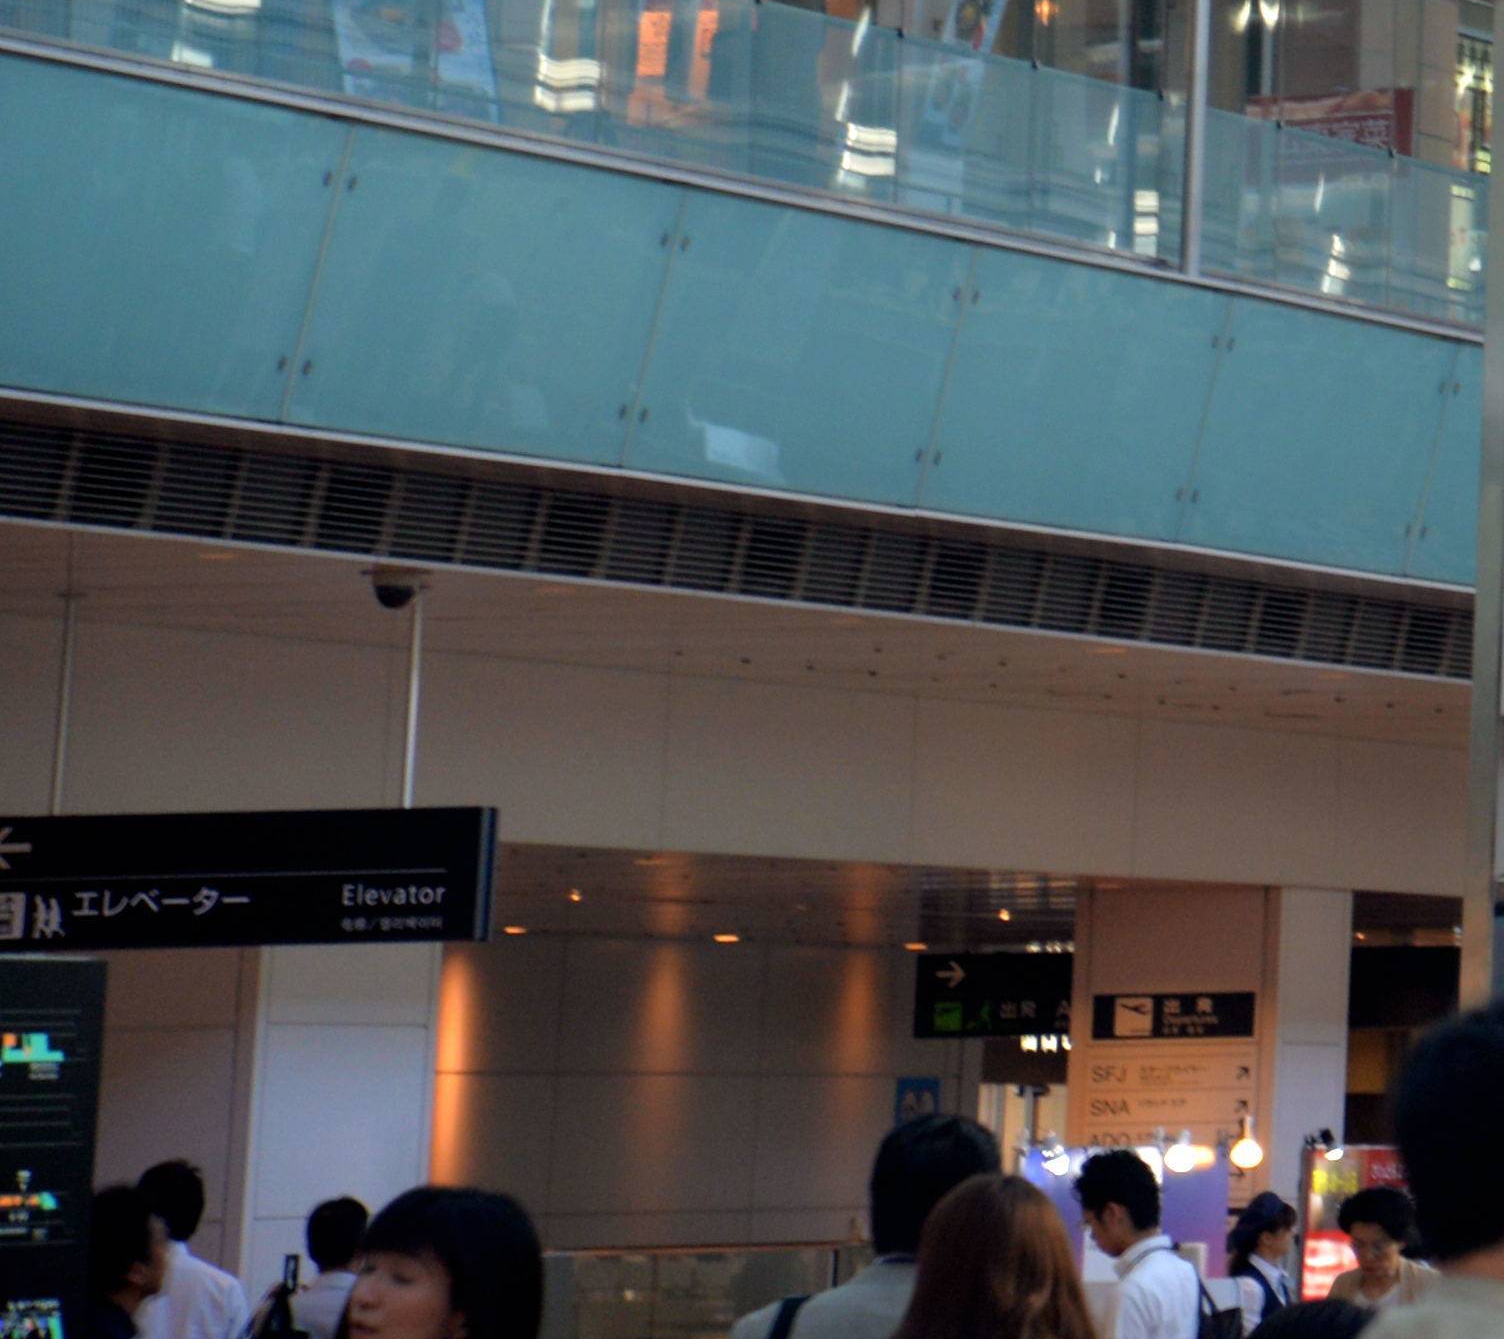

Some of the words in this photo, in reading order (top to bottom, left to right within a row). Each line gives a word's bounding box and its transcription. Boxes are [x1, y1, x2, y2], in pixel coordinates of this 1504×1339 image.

[72, 886, 251, 917] エレベーター
[341, 883, 446, 906] Elevator
[1092, 1066, 1127, 1082] SFJ
[1090, 1099, 1130, 1116] SNA
